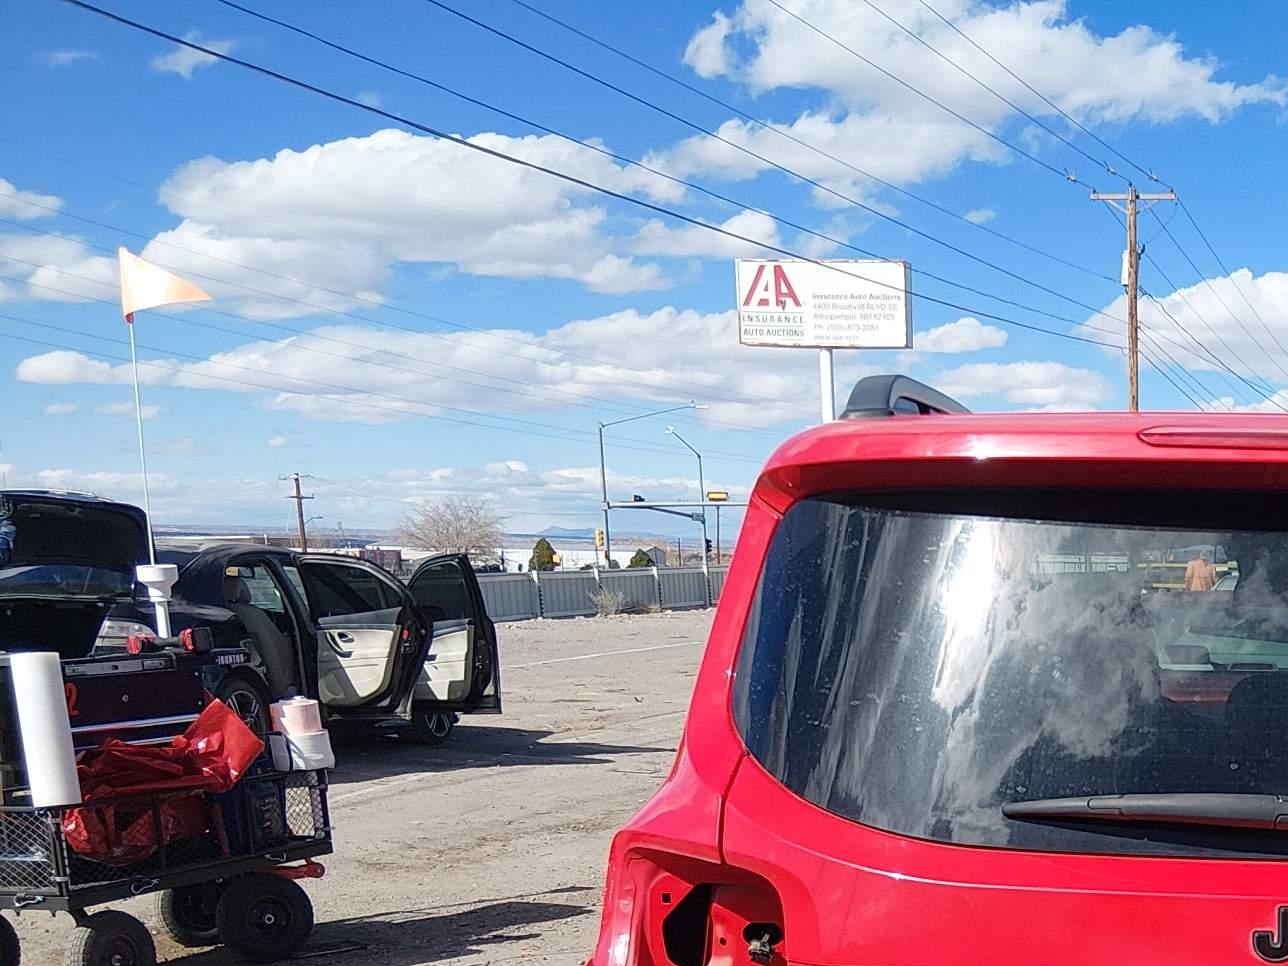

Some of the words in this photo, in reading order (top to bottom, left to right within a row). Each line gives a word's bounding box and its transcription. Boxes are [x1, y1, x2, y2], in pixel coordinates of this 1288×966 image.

[813, 292, 848, 300] Insurance
[869, 293, 901, 301] Auctions
[743, 314, 804, 323] INSURANCE
[743, 328, 764, 337] AUTO
[766, 329, 805, 337] AUCTIONS
